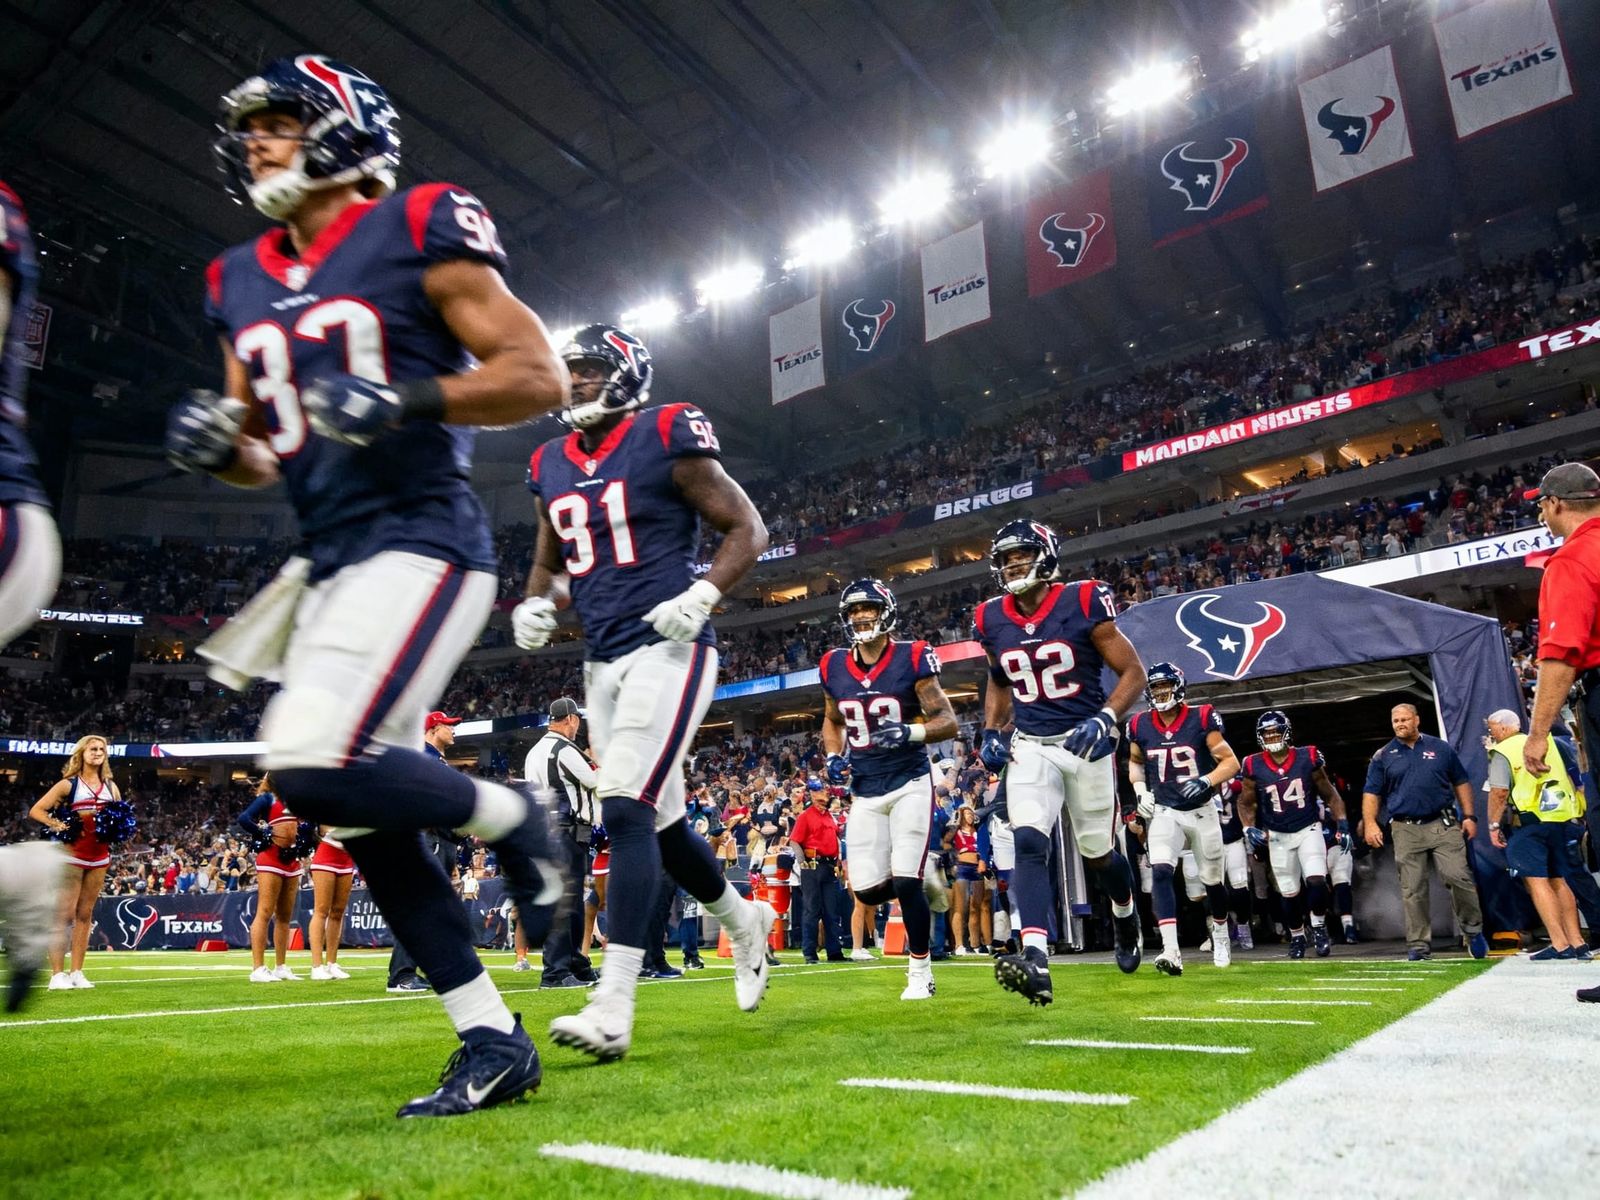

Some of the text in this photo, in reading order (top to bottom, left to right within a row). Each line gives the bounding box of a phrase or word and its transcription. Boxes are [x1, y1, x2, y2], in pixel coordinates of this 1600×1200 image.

[1450, 46, 1557, 92] Texans
[548, 480, 637, 576] 91
[1000, 641, 1082, 703] 92
[1146, 745, 1200, 784] 79
[1264, 777, 1306, 813] 14
[160, 914, 223, 935] Texans
